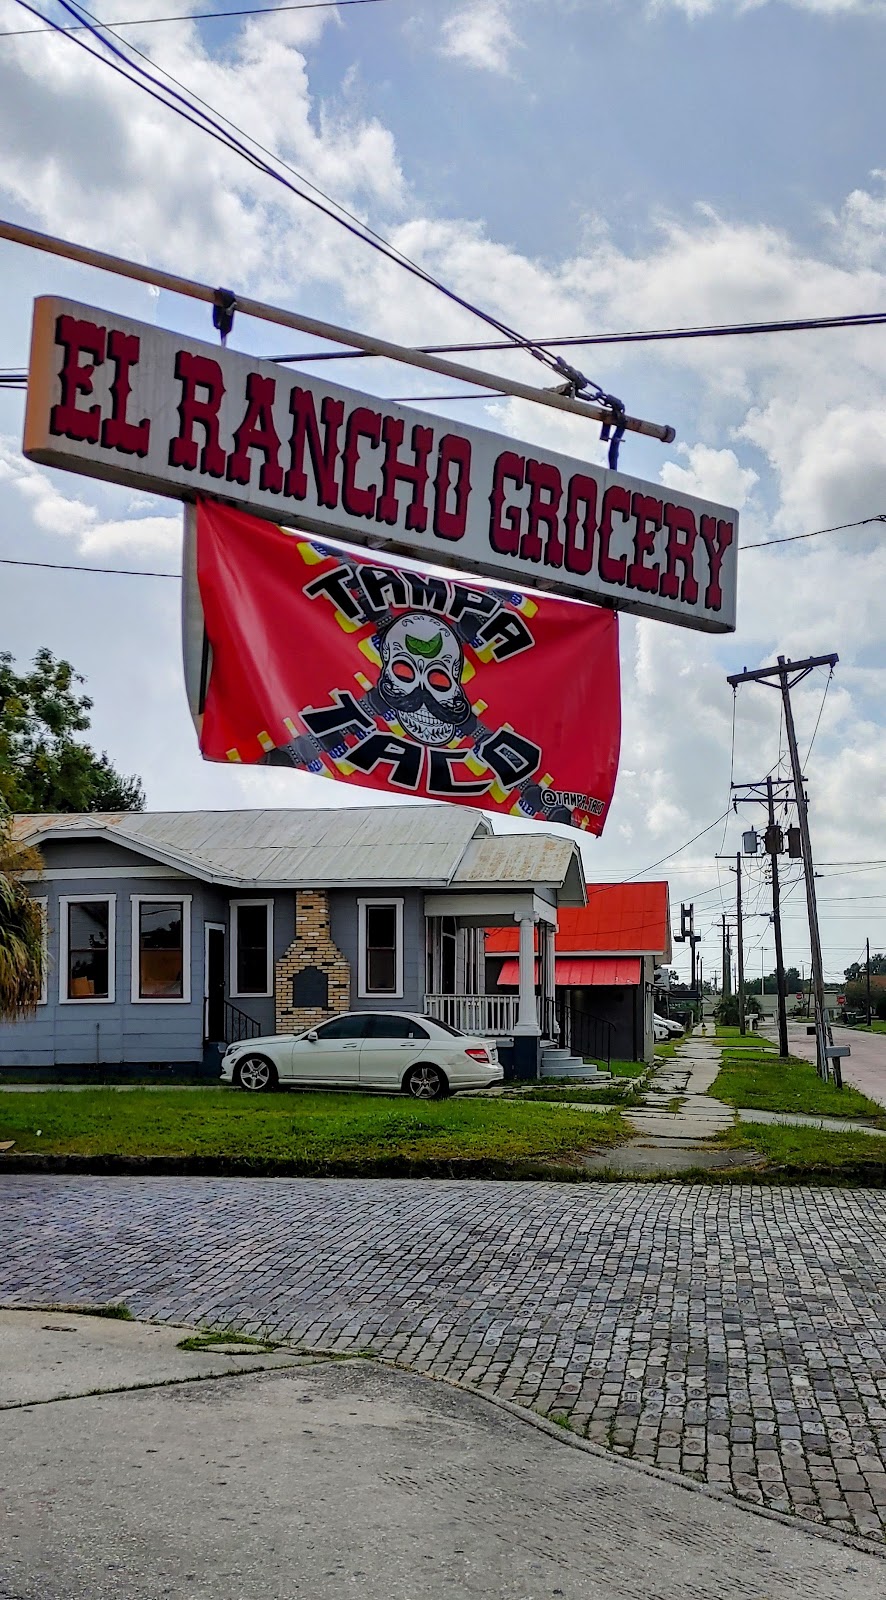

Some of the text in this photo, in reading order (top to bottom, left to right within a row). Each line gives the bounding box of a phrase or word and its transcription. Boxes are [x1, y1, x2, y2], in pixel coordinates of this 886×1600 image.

[52, 315, 734, 609] EL RANCHO GROCERY
[303, 564, 535, 662] TAMPA
[298, 691, 541, 795] TACO
